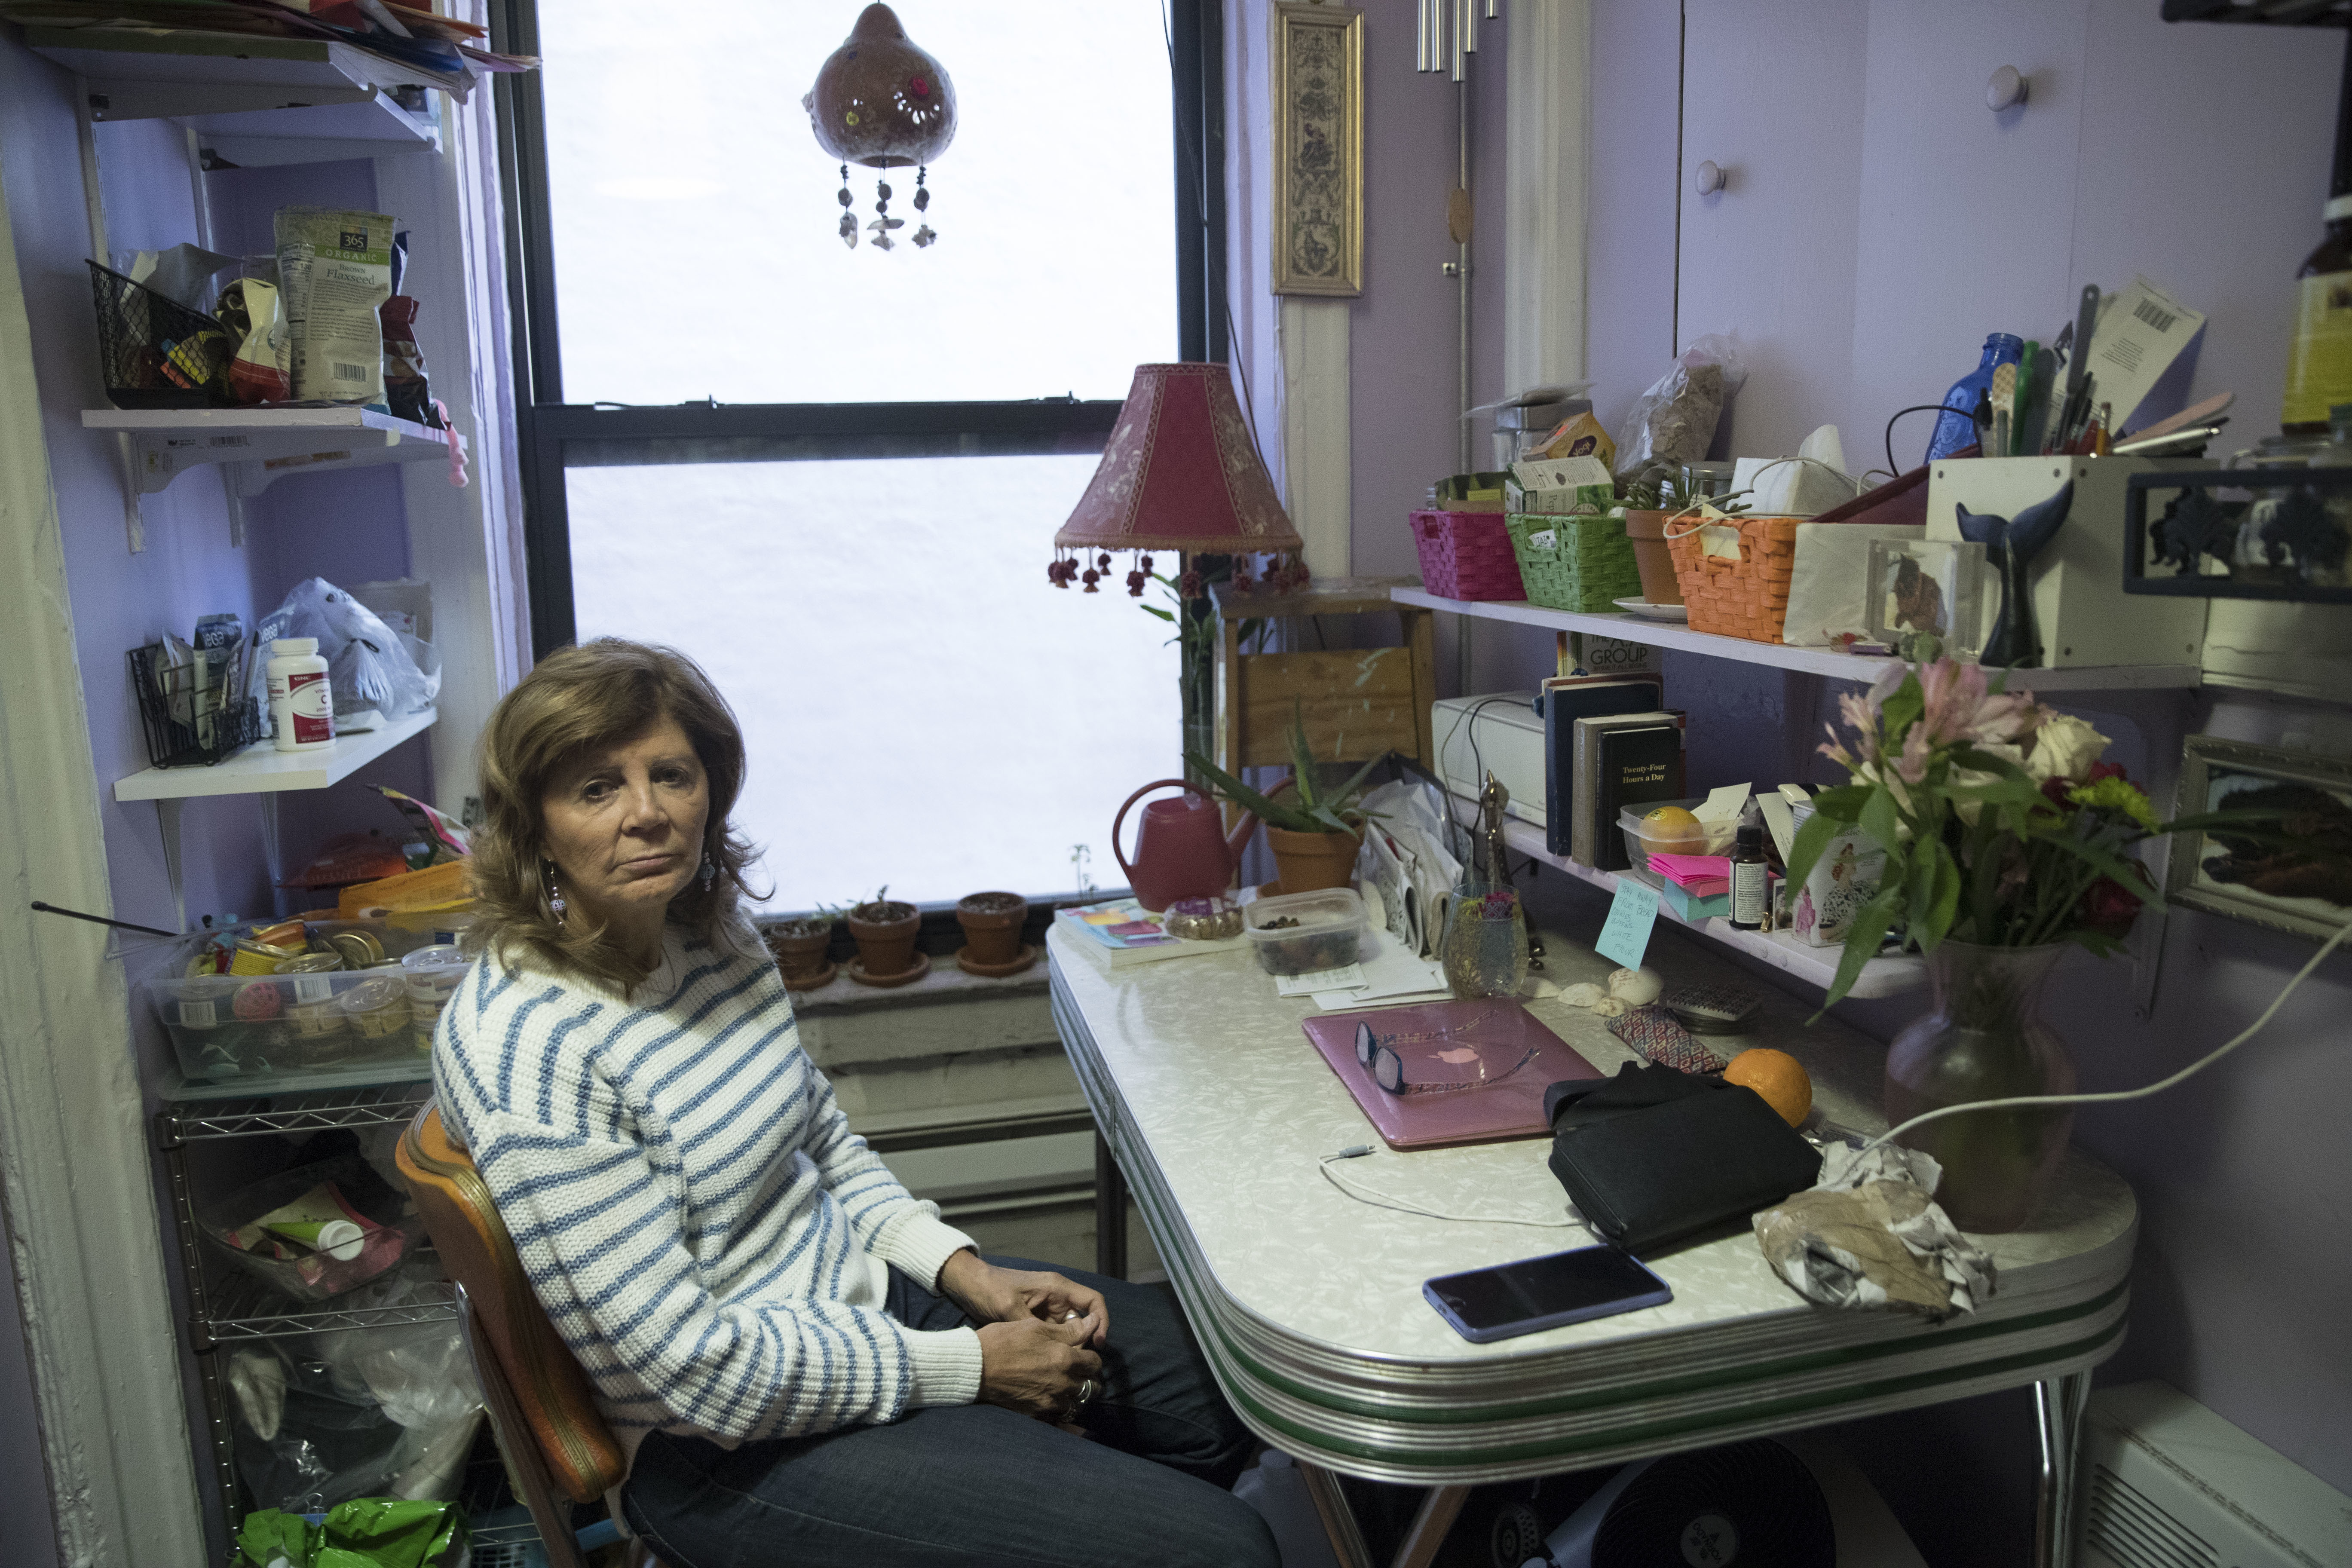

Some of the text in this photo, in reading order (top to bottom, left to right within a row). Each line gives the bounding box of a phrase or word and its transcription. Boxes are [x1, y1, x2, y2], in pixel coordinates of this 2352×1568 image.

[344, 235, 364, 248] 365
[325, 249, 377, 262] ORGANIC
[326, 268, 375, 285] Flaxseed
[1590, 647, 1648, 665] GROUP
[321, 694, 327, 704] C
[1623, 764, 1666, 774] Twenty-Four
[1620, 883, 1654, 907] STAY AWAY
[1616, 897, 1634, 910] FROM
[1612, 930, 1633, 942] WHITE
